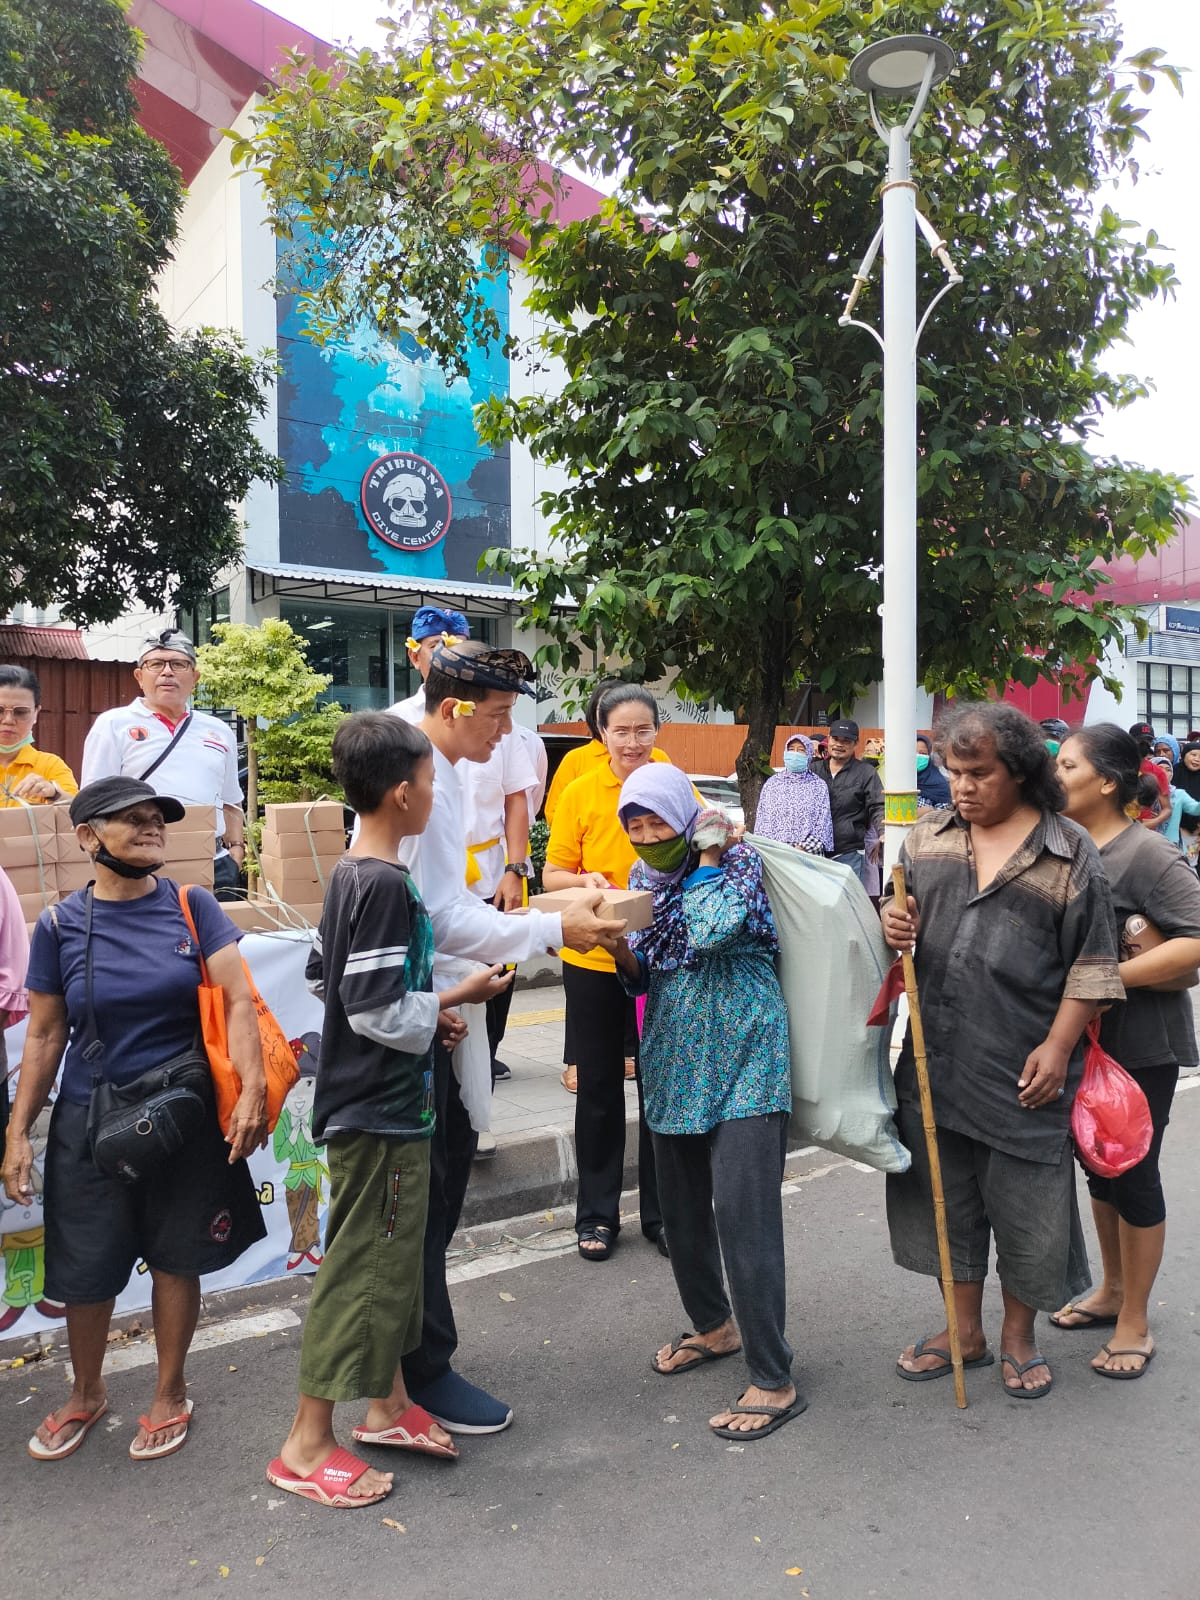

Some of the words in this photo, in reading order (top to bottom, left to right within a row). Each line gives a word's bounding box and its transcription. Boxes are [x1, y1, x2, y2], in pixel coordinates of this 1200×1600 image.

[369, 458, 444, 499] TRIBUANA
[372, 511, 400, 541] DIVE
[402, 519, 444, 546] CENTER
